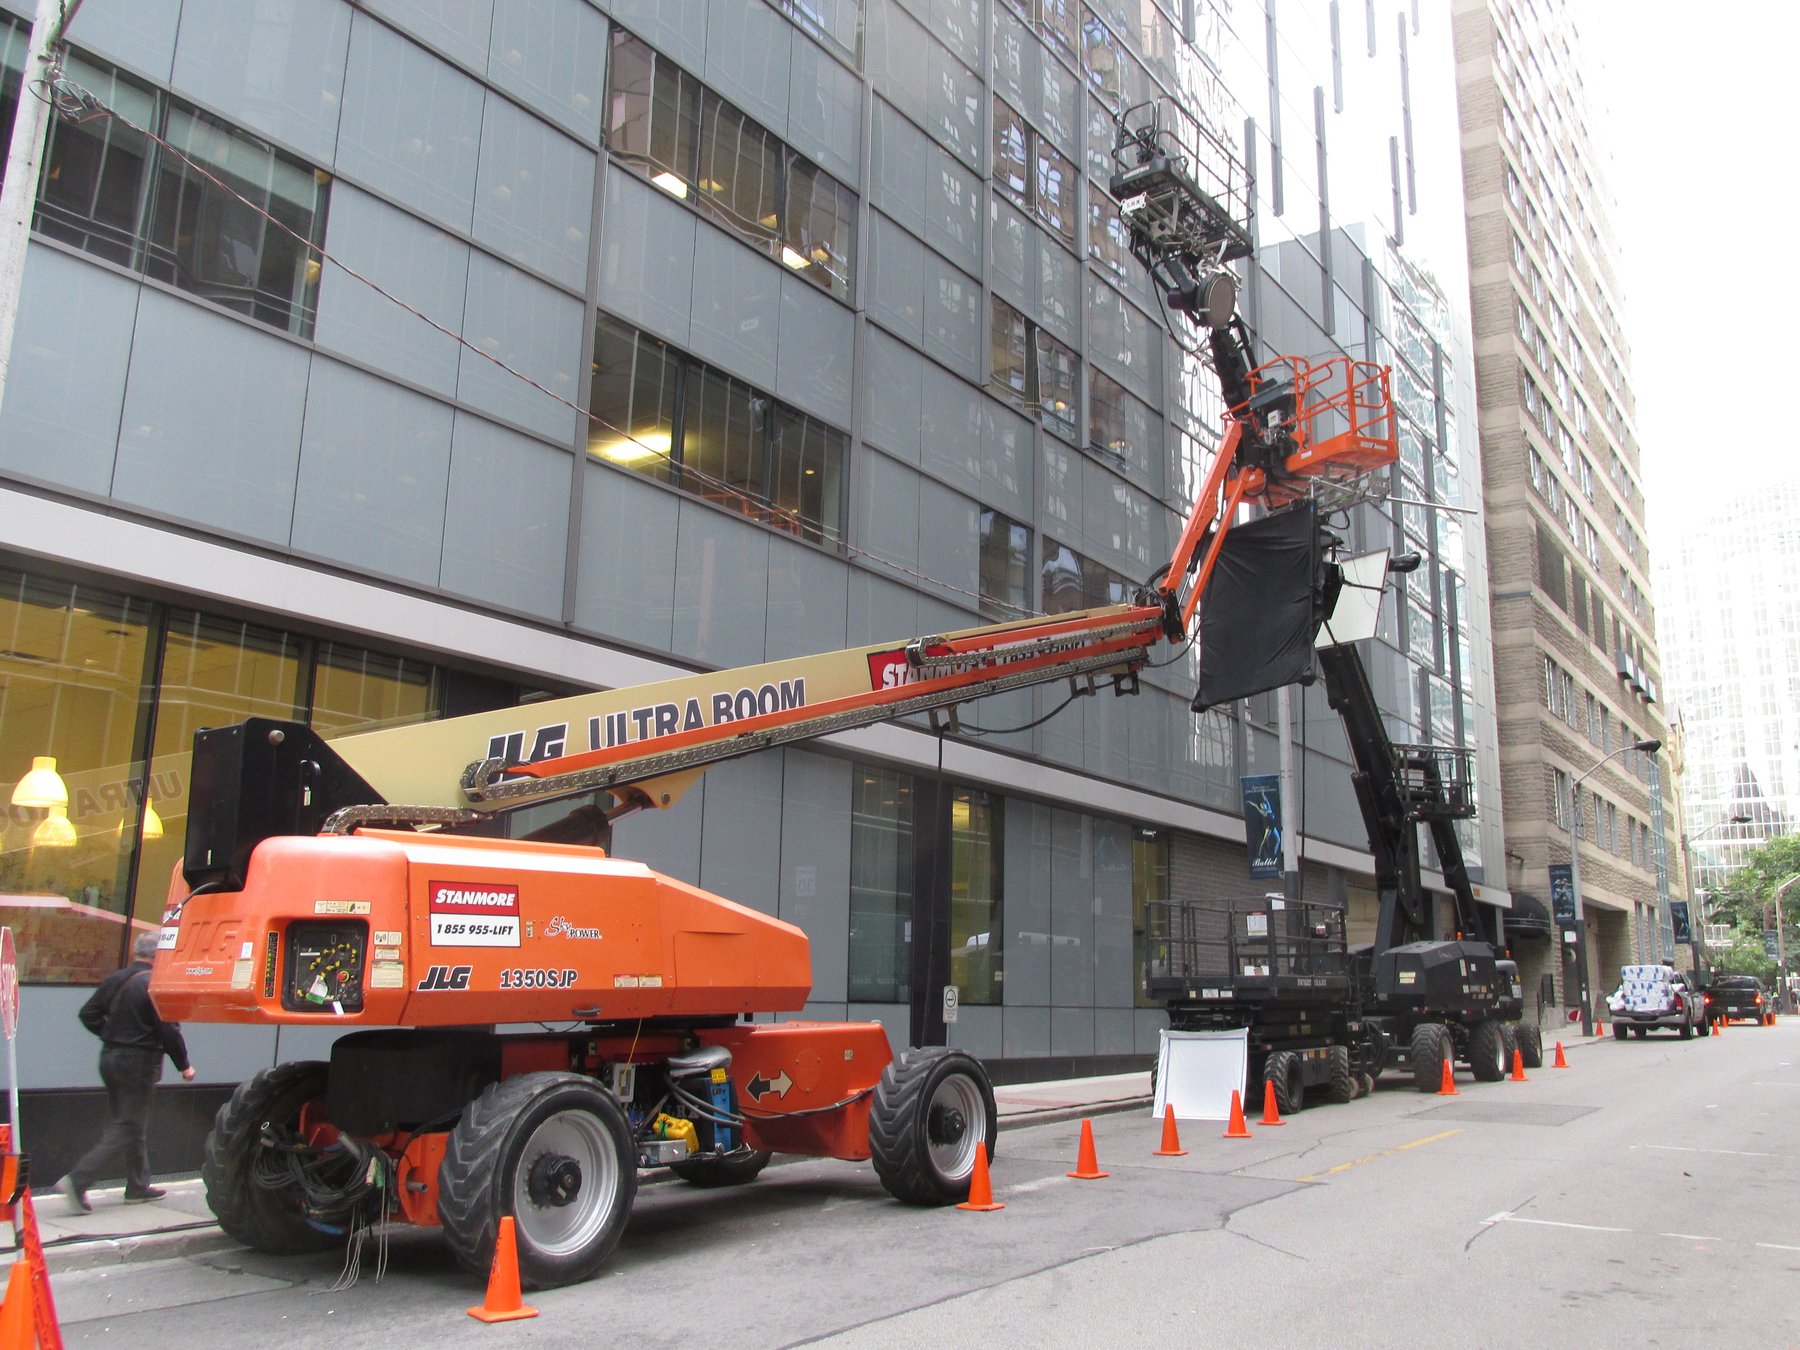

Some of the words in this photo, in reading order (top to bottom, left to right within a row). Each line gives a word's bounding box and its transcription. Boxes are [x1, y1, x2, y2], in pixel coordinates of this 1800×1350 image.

[588, 698, 704, 751] ULTRA
[711, 677, 806, 727] BOOM
[435, 889, 515, 907] STANMORE
[436, 924, 442, 934] 1
[443, 924, 465, 935] 855
[469, 925, 514, 936] 955-LIFT
[544, 916, 572, 938] Sky
[568, 928, 600, 939] POWER
[417, 965, 473, 991] JLG
[500, 968, 579, 989] 1350SJP
